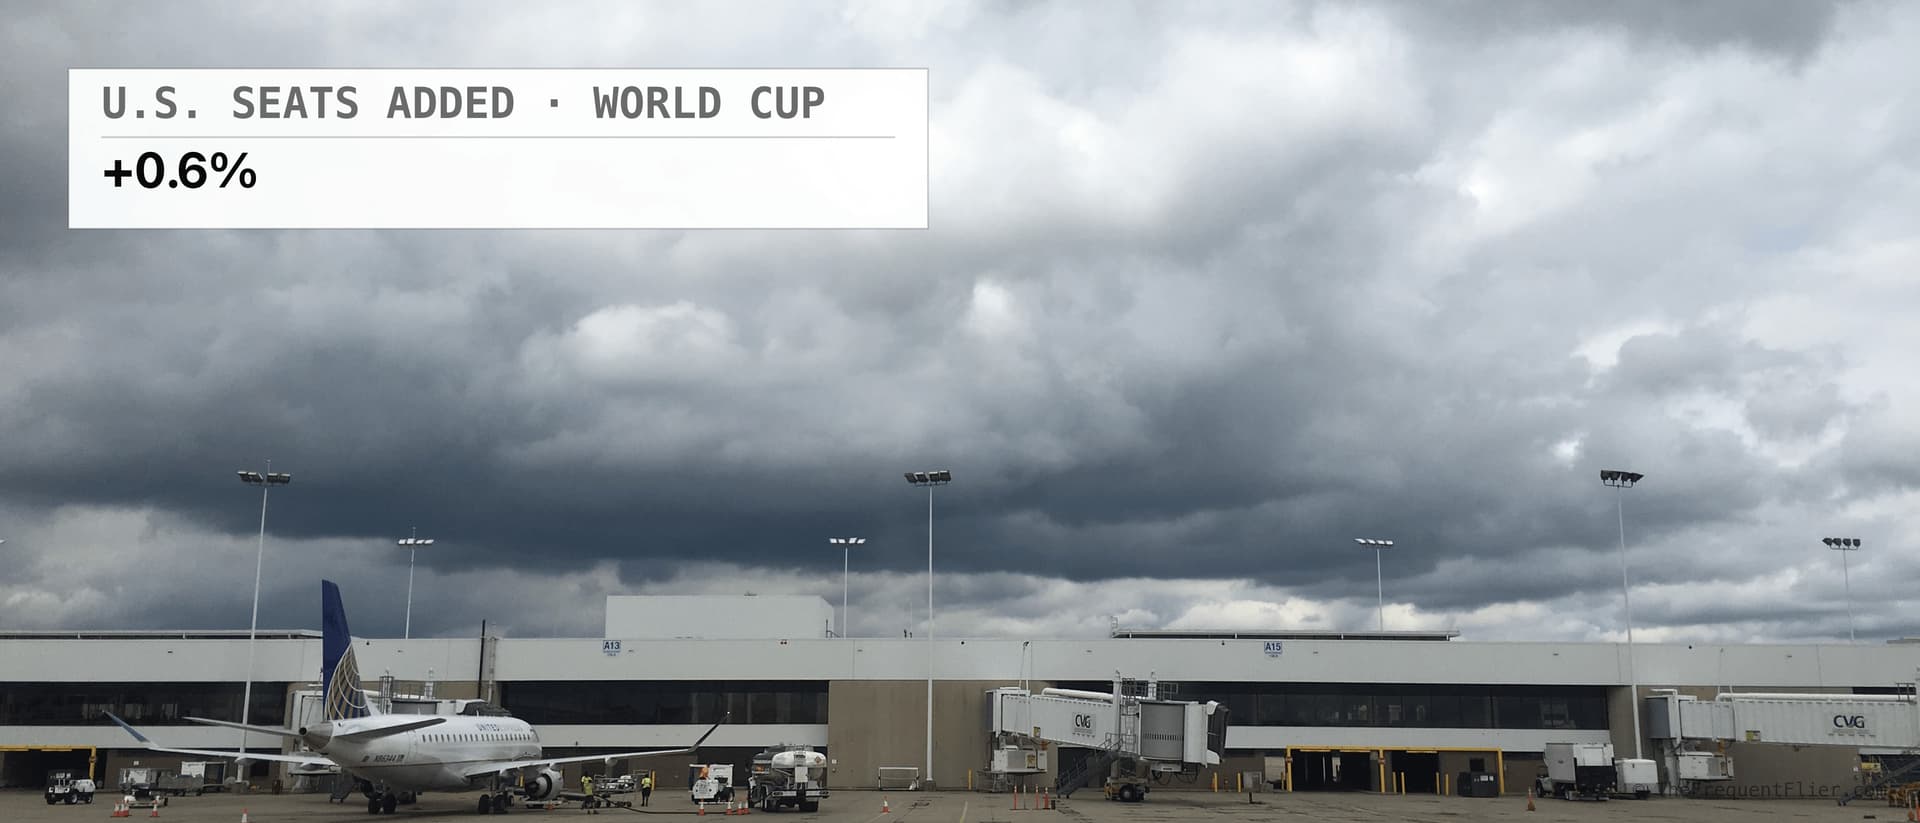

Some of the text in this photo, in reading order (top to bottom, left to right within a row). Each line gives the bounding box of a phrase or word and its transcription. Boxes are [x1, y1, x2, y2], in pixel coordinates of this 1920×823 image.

[603, 641, 620, 650] A13
[1265, 642, 1281, 651] A15
[1075, 714, 1091, 729] CVG
[1833, 714, 1865, 728] CVG
